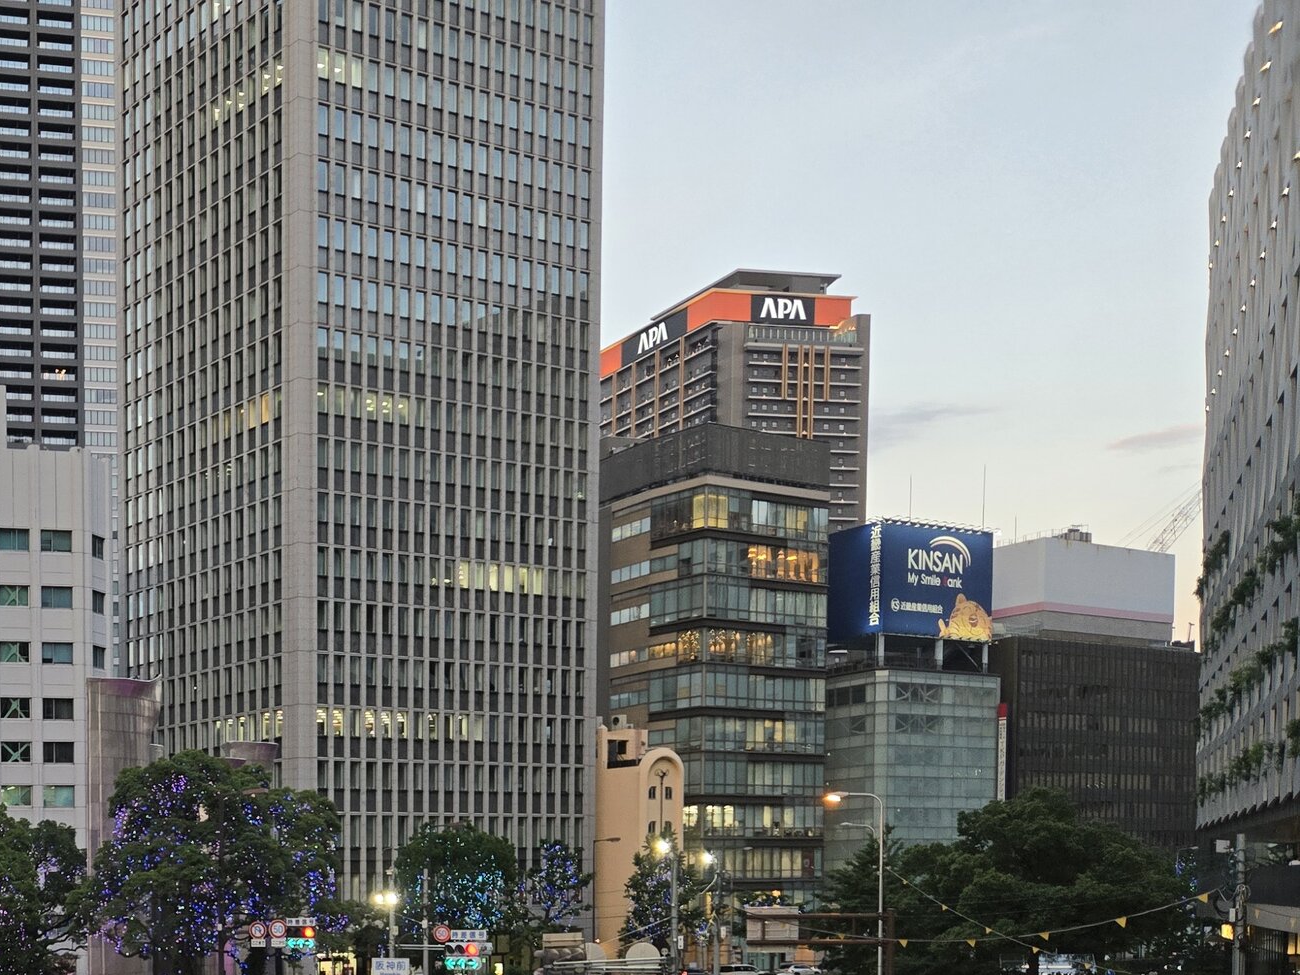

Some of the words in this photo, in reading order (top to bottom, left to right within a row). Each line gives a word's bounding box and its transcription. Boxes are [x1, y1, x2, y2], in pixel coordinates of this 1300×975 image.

[759, 297, 807, 320] APA
[637, 321, 669, 355] APA
[907, 548, 963, 574] KINSAN
[868, 523, 882, 627] 近畿産業信用組合
[907, 572, 919, 586] My
[920, 574, 941, 587] Smile
[438, 929, 447, 938] 50
[375, 961, 406, 971] 阪神前
